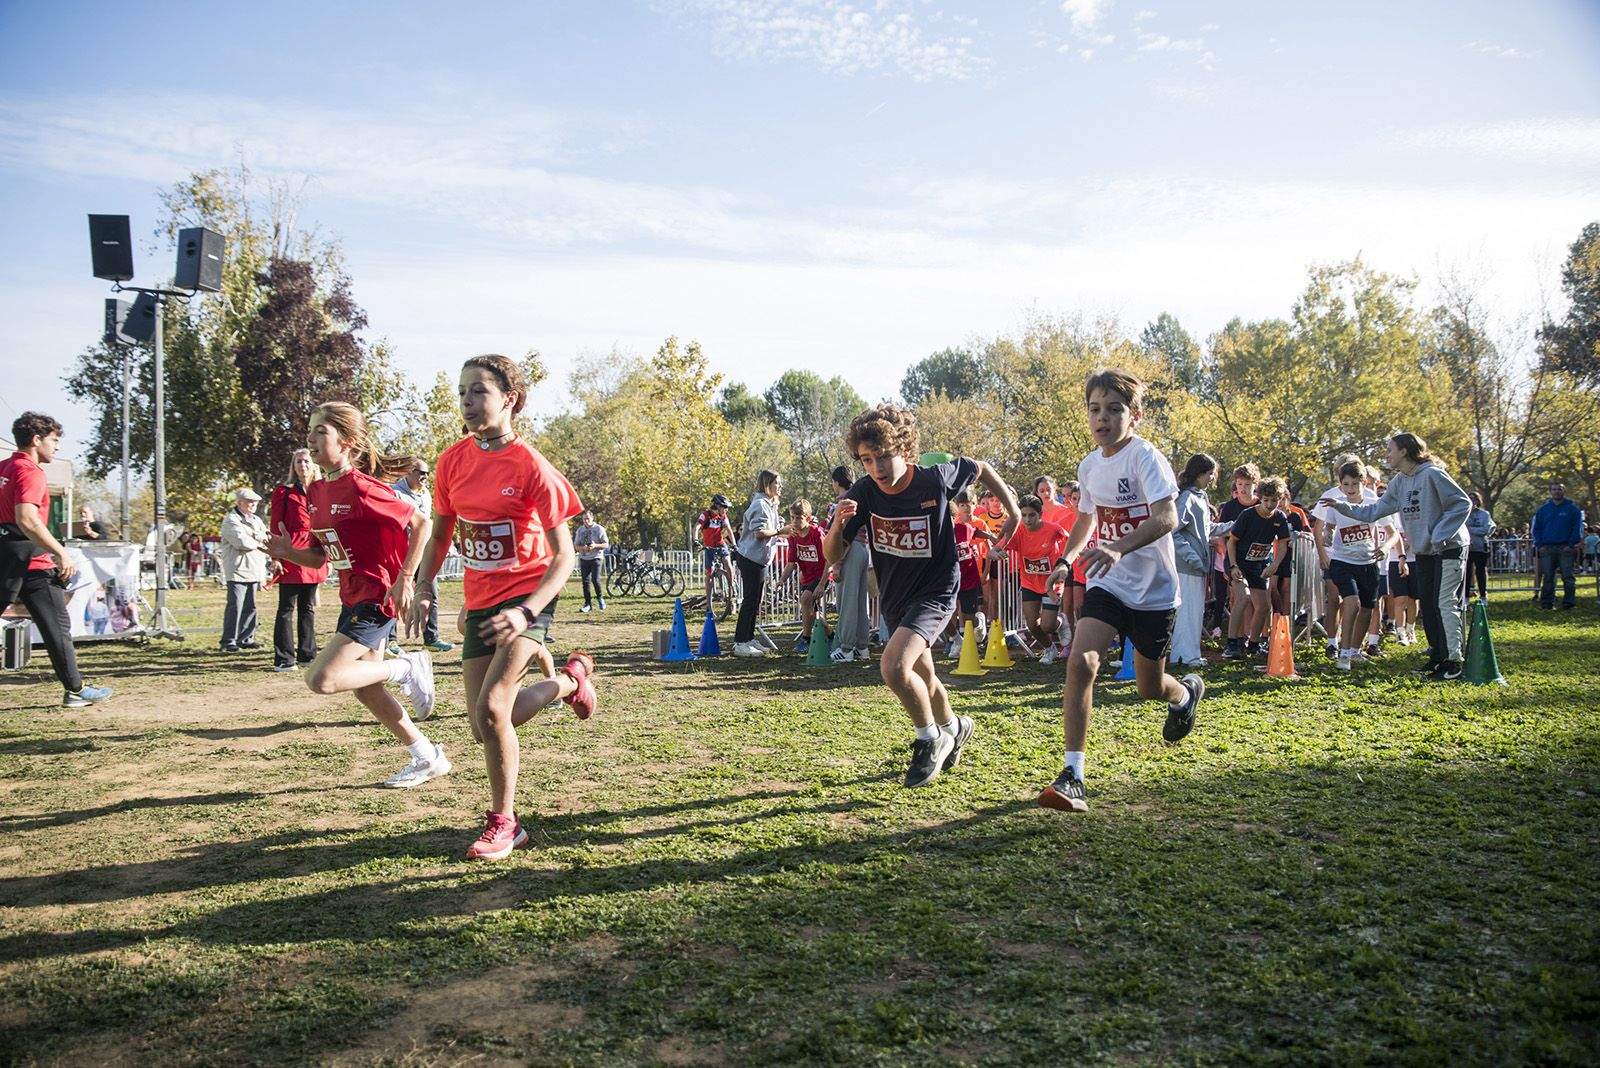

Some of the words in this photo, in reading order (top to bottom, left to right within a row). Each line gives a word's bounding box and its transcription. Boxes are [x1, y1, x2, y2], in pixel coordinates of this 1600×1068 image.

[876, 529, 927, 549] 3746
[1343, 530, 1371, 543] 4202
[464, 538, 504, 560] 989
